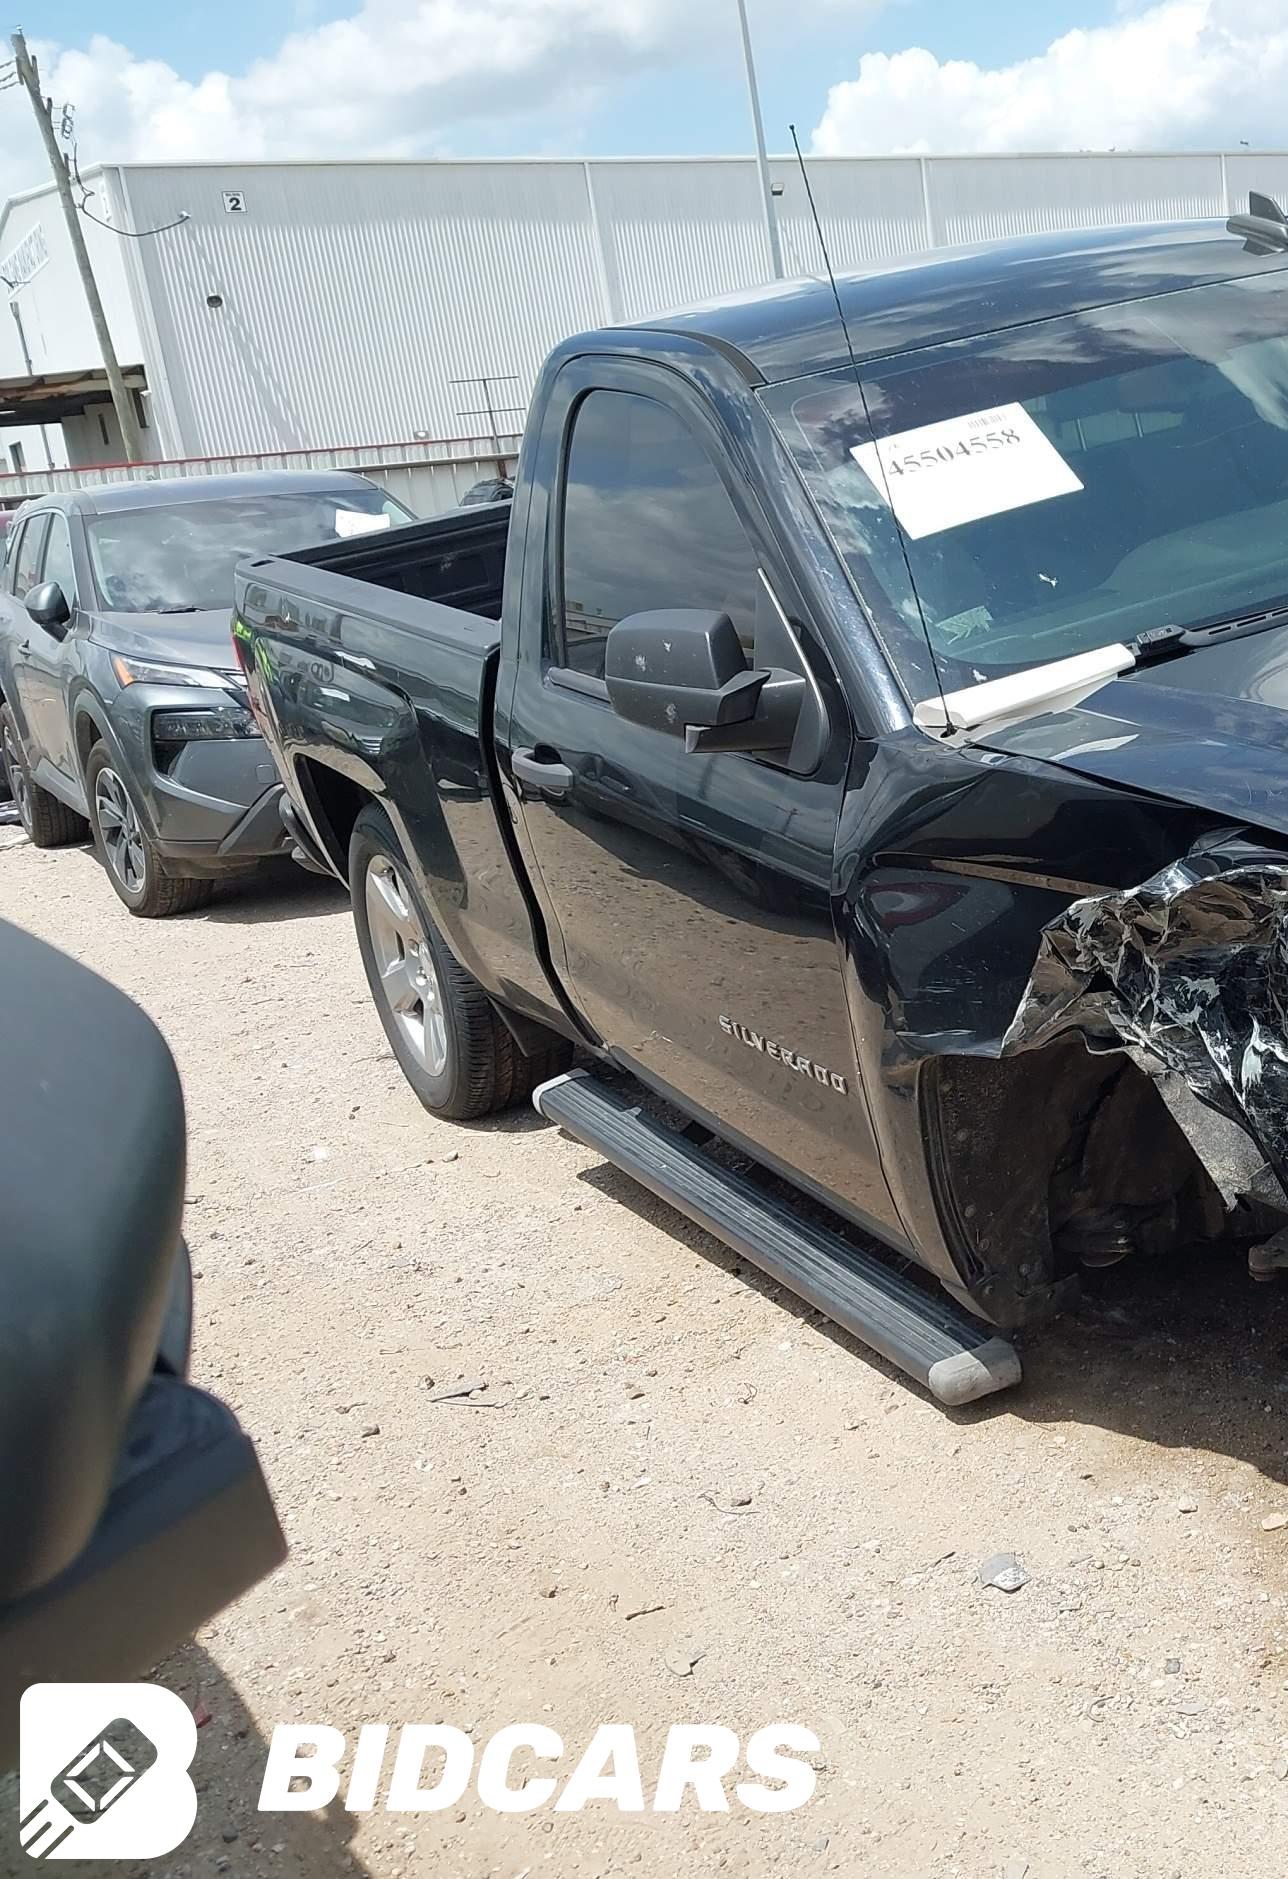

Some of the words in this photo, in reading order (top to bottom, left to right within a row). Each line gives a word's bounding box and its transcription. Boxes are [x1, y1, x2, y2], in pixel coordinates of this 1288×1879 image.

[229, 197, 242, 211] 2
[888, 427, 1021, 476] 45504558
[719, 1014, 848, 1095] SILVERADO
